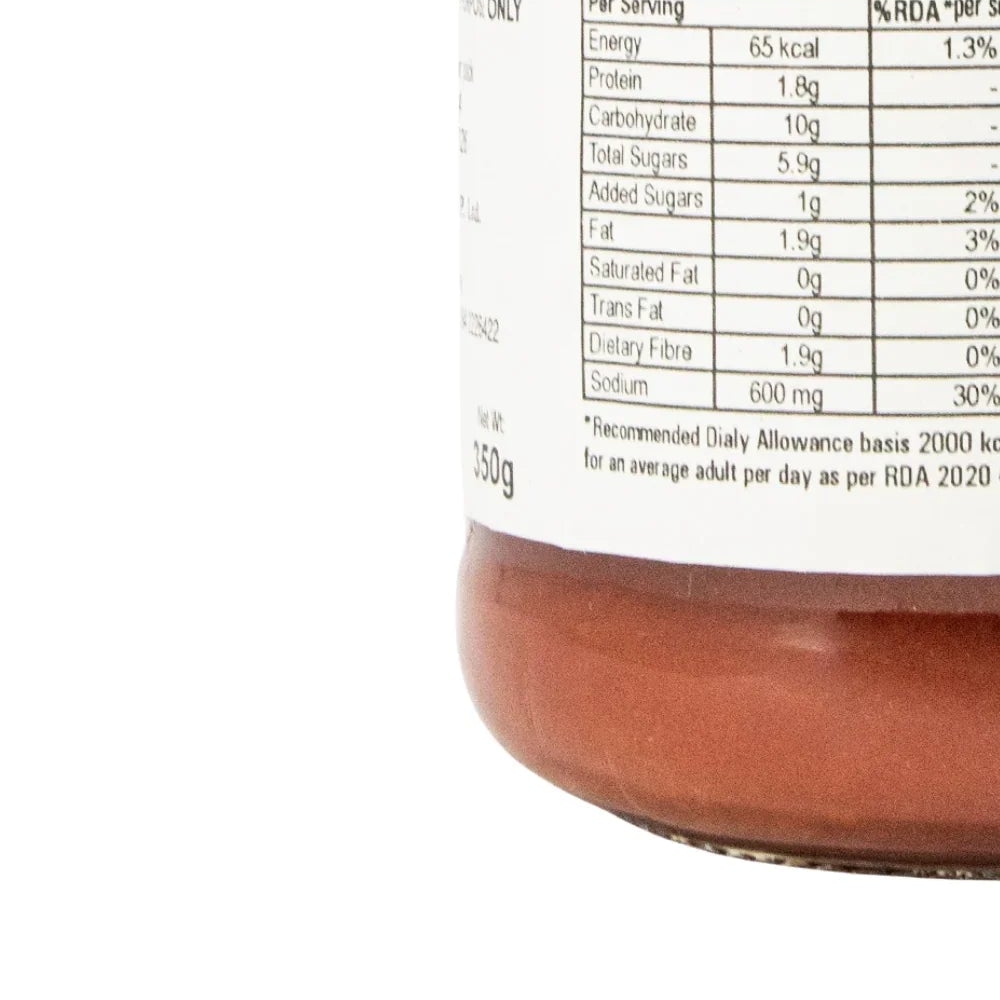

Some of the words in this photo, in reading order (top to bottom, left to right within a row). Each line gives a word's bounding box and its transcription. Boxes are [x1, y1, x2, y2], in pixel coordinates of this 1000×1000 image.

[588, 29, 642, 59] Energy
[750, 37, 773, 58] 65
[779, 36, 819, 58] kcal
[944, 37, 997, 59] 1.3%
[589, 66, 642, 91] Protein
[778, 76, 819, 104] 1.8g
[589, 105, 696, 135] Carbohydrate
[785, 114, 820, 142] 10g
[589, 142, 624, 165] Total
[630, 145, 687, 176] Sugars
[778, 152, 820, 180] 5.9g
[589, 183, 638, 206] Added
[644, 185, 703, 214] Sugars
[798, 192, 821, 219] 1g
[964, 192, 999, 213] 2%
[589, 219, 613, 242] Fat
[779, 230, 821, 257] 1.9g
[964, 231, 1000, 253] 3%
[589, 259, 664, 283] Saturated
[670, 263, 699, 285] Fat
[797, 268, 822, 295] 0g
[964, 268, 1000, 290] 0%
[590, 295, 633, 319] Trans
[637, 299, 663, 321] Fat
[798, 306, 822, 334] 0g
[964, 307, 1000, 329] 0%
[589, 332, 644, 364] Dietary
[649, 337, 692, 362] Fibre
[781, 345, 823, 372] 1.9g
[965, 345, 1000, 368] 0%
[590, 371, 648, 396] Sodium
[749, 382, 785, 405] 600
[792, 387, 823, 413] mg
[706, 426, 749, 453] Dialy
[757, 429, 853, 452] Allowance
[860, 431, 910, 453] basis
[919, 431, 972, 453] 2000
[474, 440, 514, 500] 350g
[583, 447, 602, 470] for
[609, 456, 625, 473] an
[630, 459, 689, 483] average
[695, 459, 737, 482] adult
[744, 467, 771, 487] per
[779, 464, 812, 490] day
[820, 470, 839, 486] as
[847, 470, 876, 491] per
[884, 464, 930, 487] RDA
[938, 464, 991, 487] 2020
